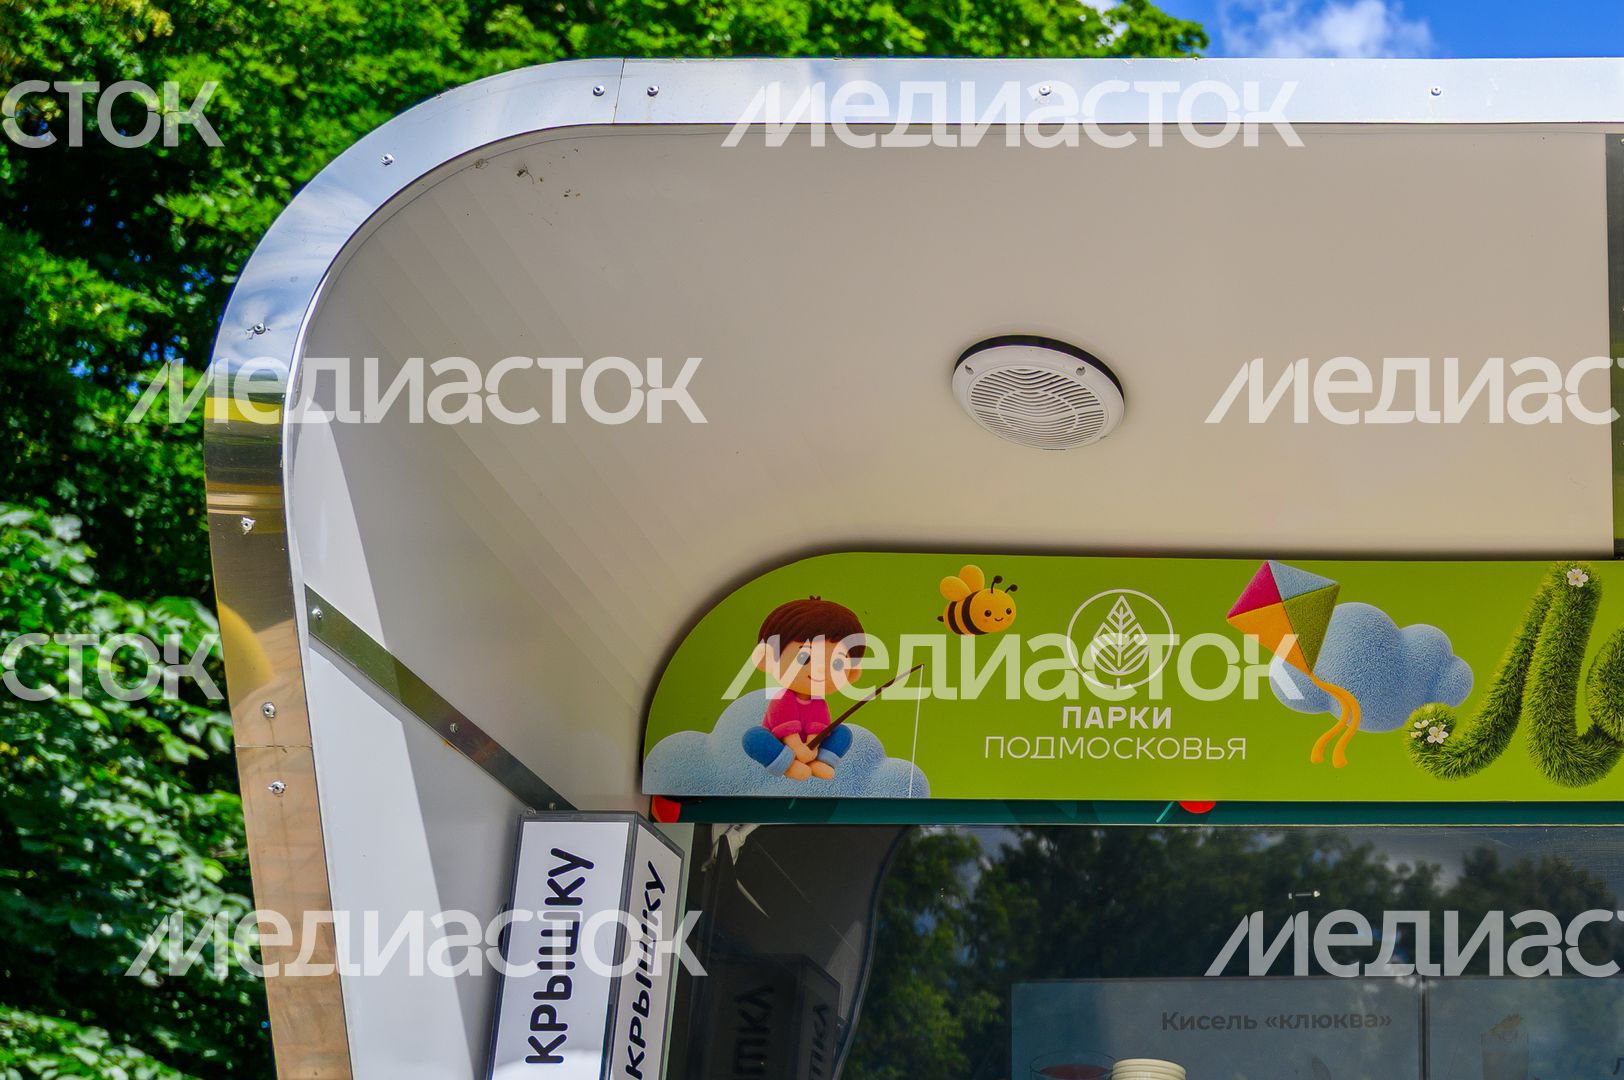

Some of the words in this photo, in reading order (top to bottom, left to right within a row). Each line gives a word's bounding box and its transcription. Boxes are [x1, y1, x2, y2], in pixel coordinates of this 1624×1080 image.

[1061, 706, 1172, 730] ПАРКИ
[984, 736, 1247, 761] ПОДМОСКОВЬЯ
[524, 847, 594, 1064] КРЫШКУ
[625, 860, 666, 1080] КРЫШКУ
[1160, 1011, 1258, 1031] Кисель
[1264, 1011, 1393, 1030] «клюква»
